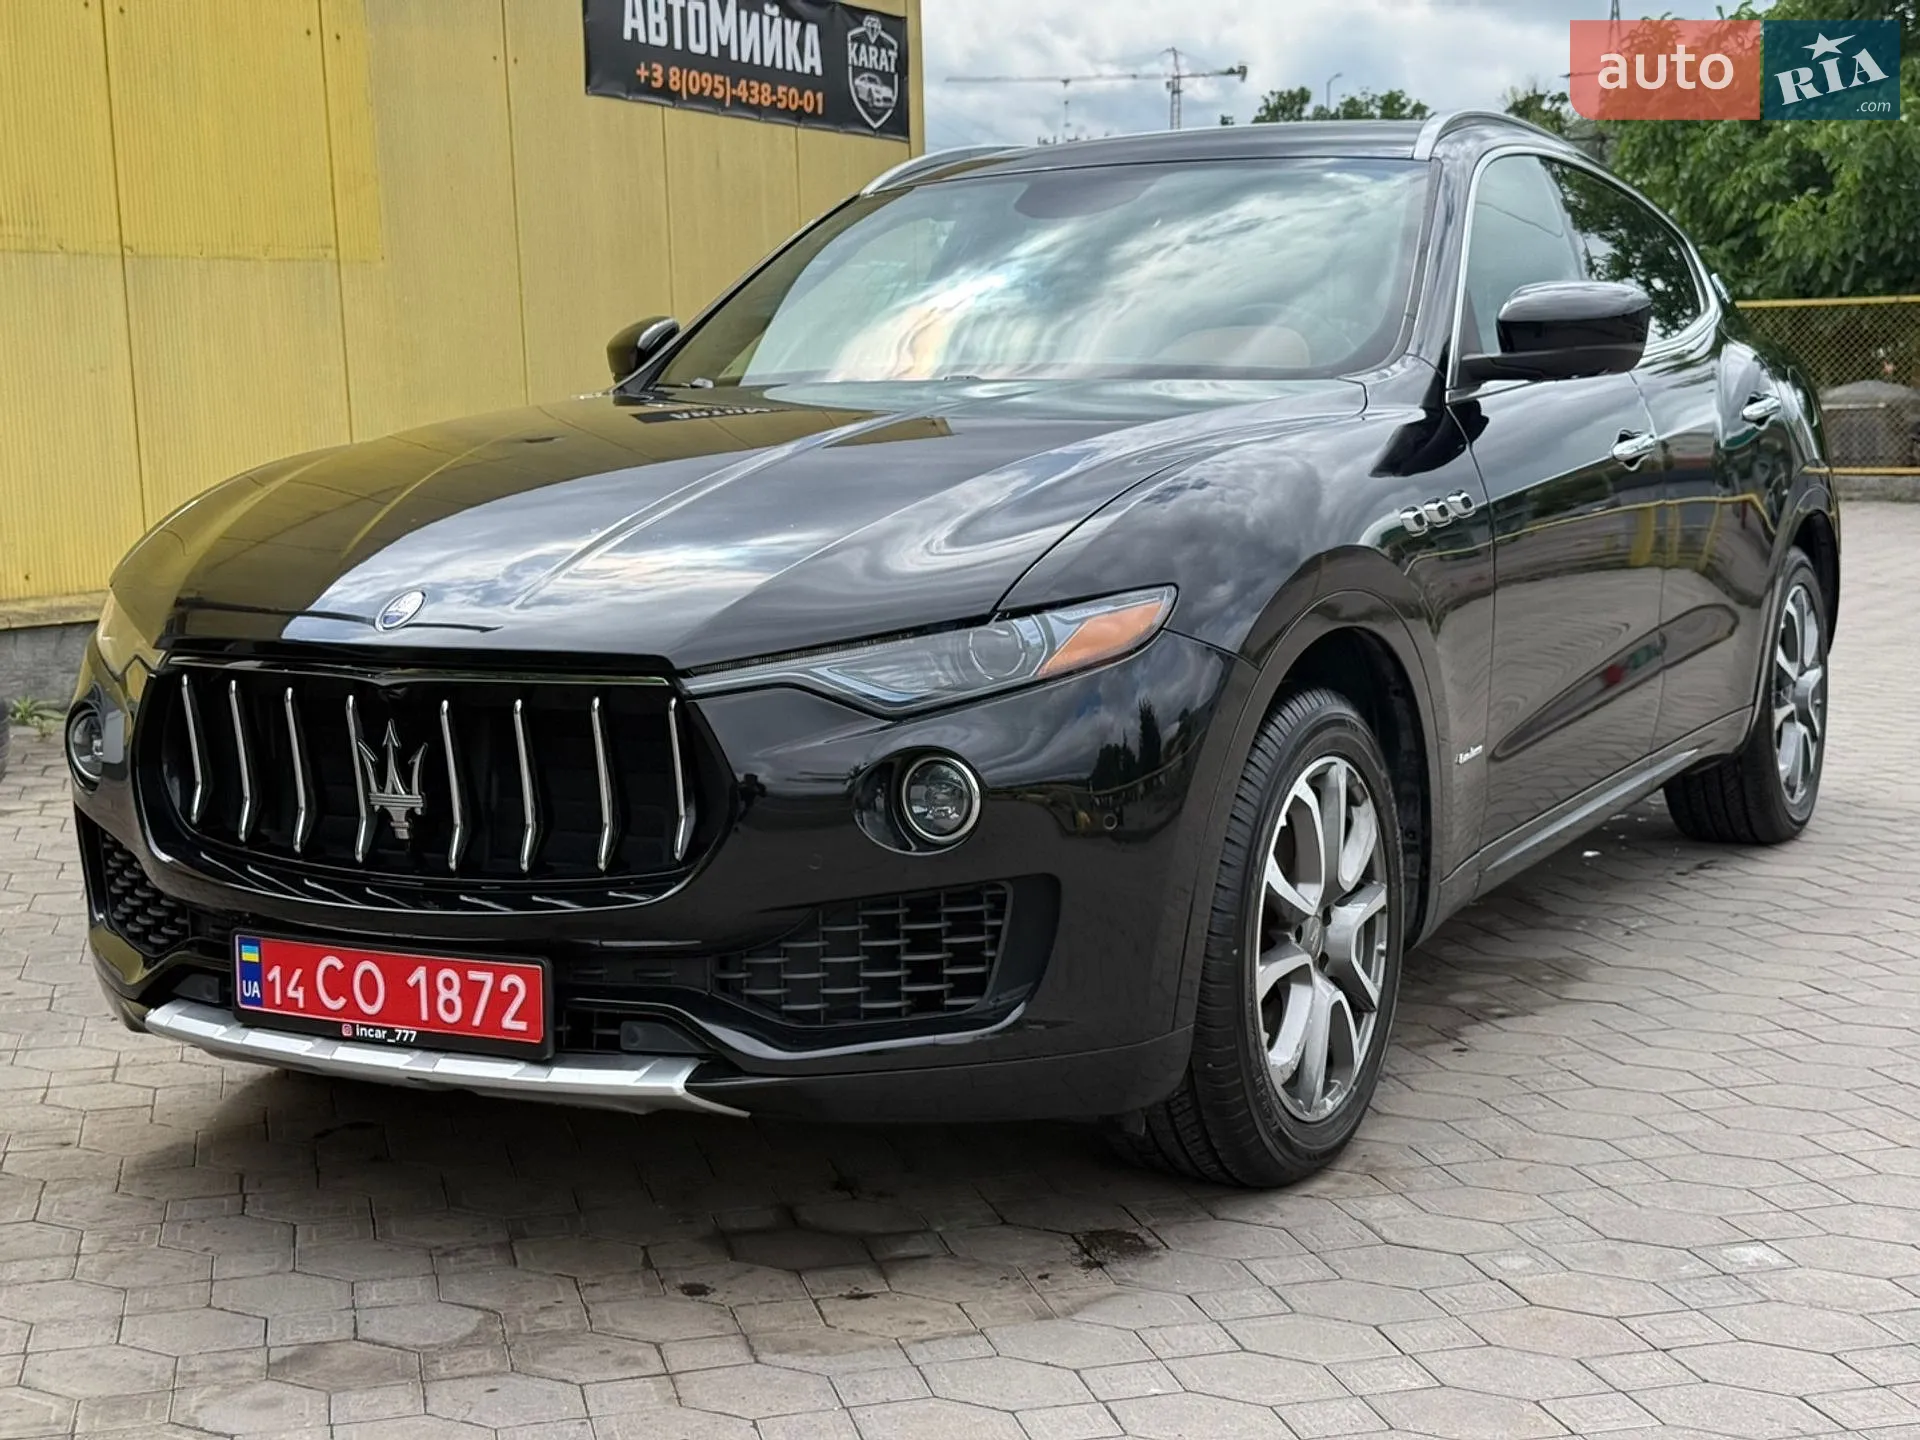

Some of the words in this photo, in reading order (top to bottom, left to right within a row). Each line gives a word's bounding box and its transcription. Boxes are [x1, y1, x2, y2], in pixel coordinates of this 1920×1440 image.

[848, 42, 898, 73] KARAT
[242, 979, 261, 999] UA
[406, 966, 528, 1031] 1872
[356, 1023, 417, 1043] incar_777
